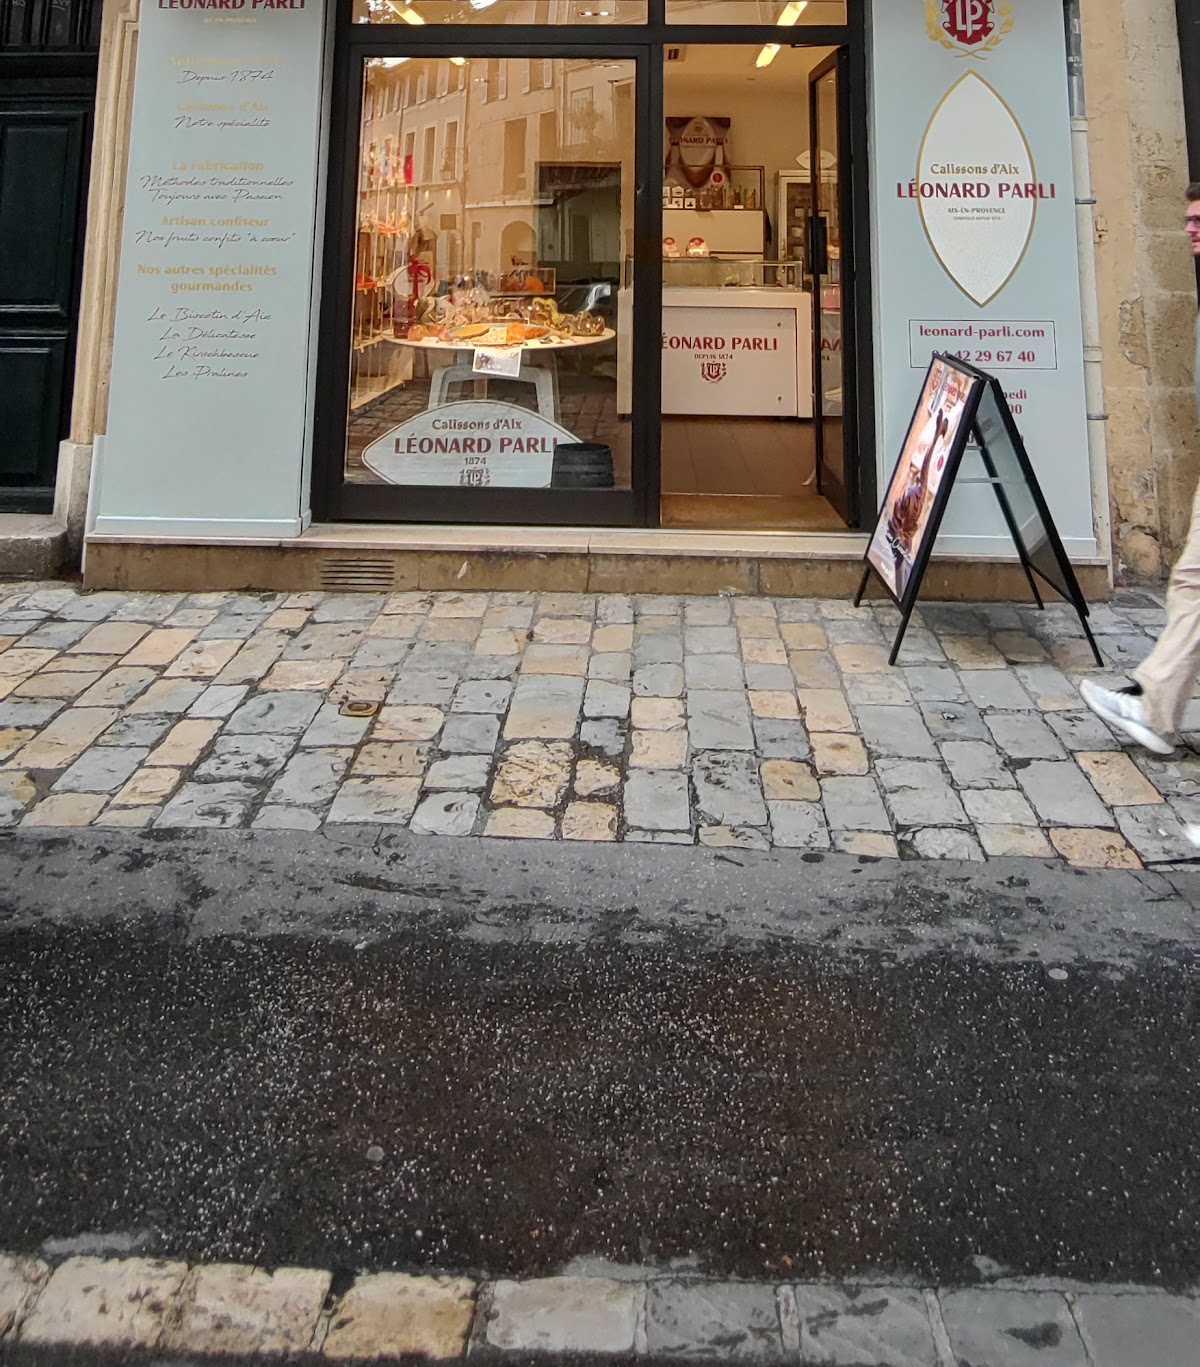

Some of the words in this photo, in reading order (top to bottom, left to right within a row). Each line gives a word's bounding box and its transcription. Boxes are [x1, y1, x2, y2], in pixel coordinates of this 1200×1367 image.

[177, 70, 225, 85] Depuis
[229, 69, 274, 83] 1874
[175, 115, 214, 129] Notre
[216, 117, 271, 132] spécialité
[930, 163, 988, 175] Calissons
[990, 163, 1020, 175] d'Aix
[209, 176, 294, 187] traditionnelles
[897, 178, 991, 199] LÉONARD
[997, 183, 1056, 199] PARLI
[148, 188, 201, 206] Toujours
[231, 188, 283, 204] Passion
[161, 216, 207, 227] Artisan
[210, 216, 270, 228] confiseur
[135, 229, 165, 244] Nos
[163, 232, 200, 248] fruits
[202, 232, 243, 249] confits
[137, 263, 162, 276] Nos
[164, 264, 206, 277] autres
[208, 263, 278, 278] spécialités
[170, 280, 254, 295] gourmandes
[147, 307, 167, 322] Le
[169, 307, 229, 322] Biscotin
[230, 307, 273, 324] d'Aix
[159, 326, 181, 341] La
[181, 326, 257, 342] Délicatesse
[919, 324, 1046, 341] leonard-parli.com
[661, 332, 726, 350] ÉONARD
[731, 336, 778, 351] PARLI
[153, 345, 173, 360] Le
[954, 350, 972, 362] 42
[974, 350, 992, 363] 29
[996, 350, 1013, 363] 67
[1017, 351, 1036, 363] 40
[161, 365, 189, 380] Les
[192, 365, 249, 381] Pralines
[431, 418, 491, 431] Calissons
[493, 418, 523, 430] d'Aix
[394, 433, 492, 454] LÉONARD
[464, 456, 487, 465] 1874
